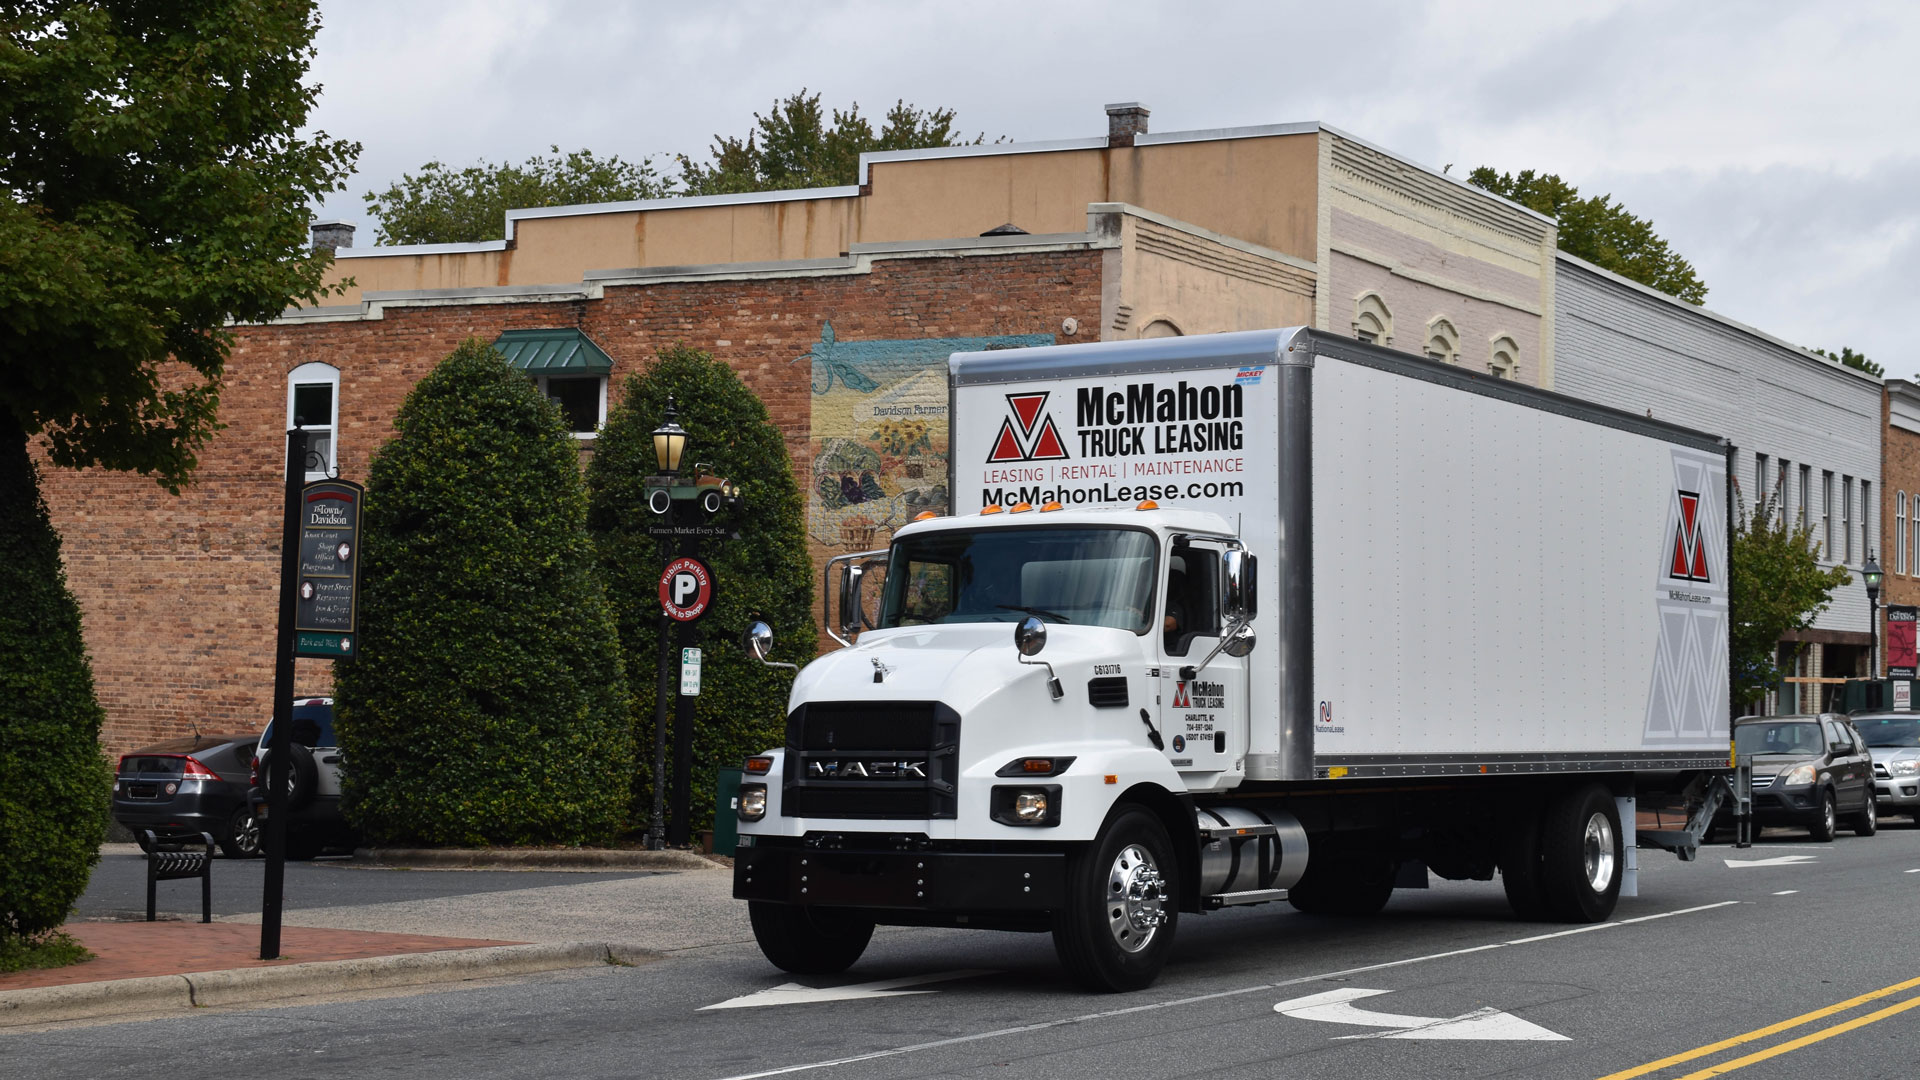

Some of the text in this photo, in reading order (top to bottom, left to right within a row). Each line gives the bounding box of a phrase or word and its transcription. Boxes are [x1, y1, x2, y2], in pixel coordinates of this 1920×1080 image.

[874, 406, 912, 416] Davidson
[1077, 381, 1243, 427] McMahon
[1078, 421, 1243, 458] TRUCK LEASING
[984, 458, 1244, 484] LEASING RENTAL MAINTENANCE
[982, 481, 1244, 508] McMahonLease.com
[320, 504, 339, 514] Town
[311, 513, 347, 524] Davidson
[649, 526, 726, 536] Farmers Market Every Sat.
[662, 561, 707, 586] Public Parking
[674, 574, 696, 605] P
[1669, 590, 1712, 604] McMahonLease.com
[665, 600, 704, 618] Walk to Shops
[1192, 681, 1224, 697] McMahon
[1192, 697, 1224, 708] TRUCK LEASING
[1185, 714, 1208, 722] CHARLOTTE,
[808, 761, 926, 777] MACK
